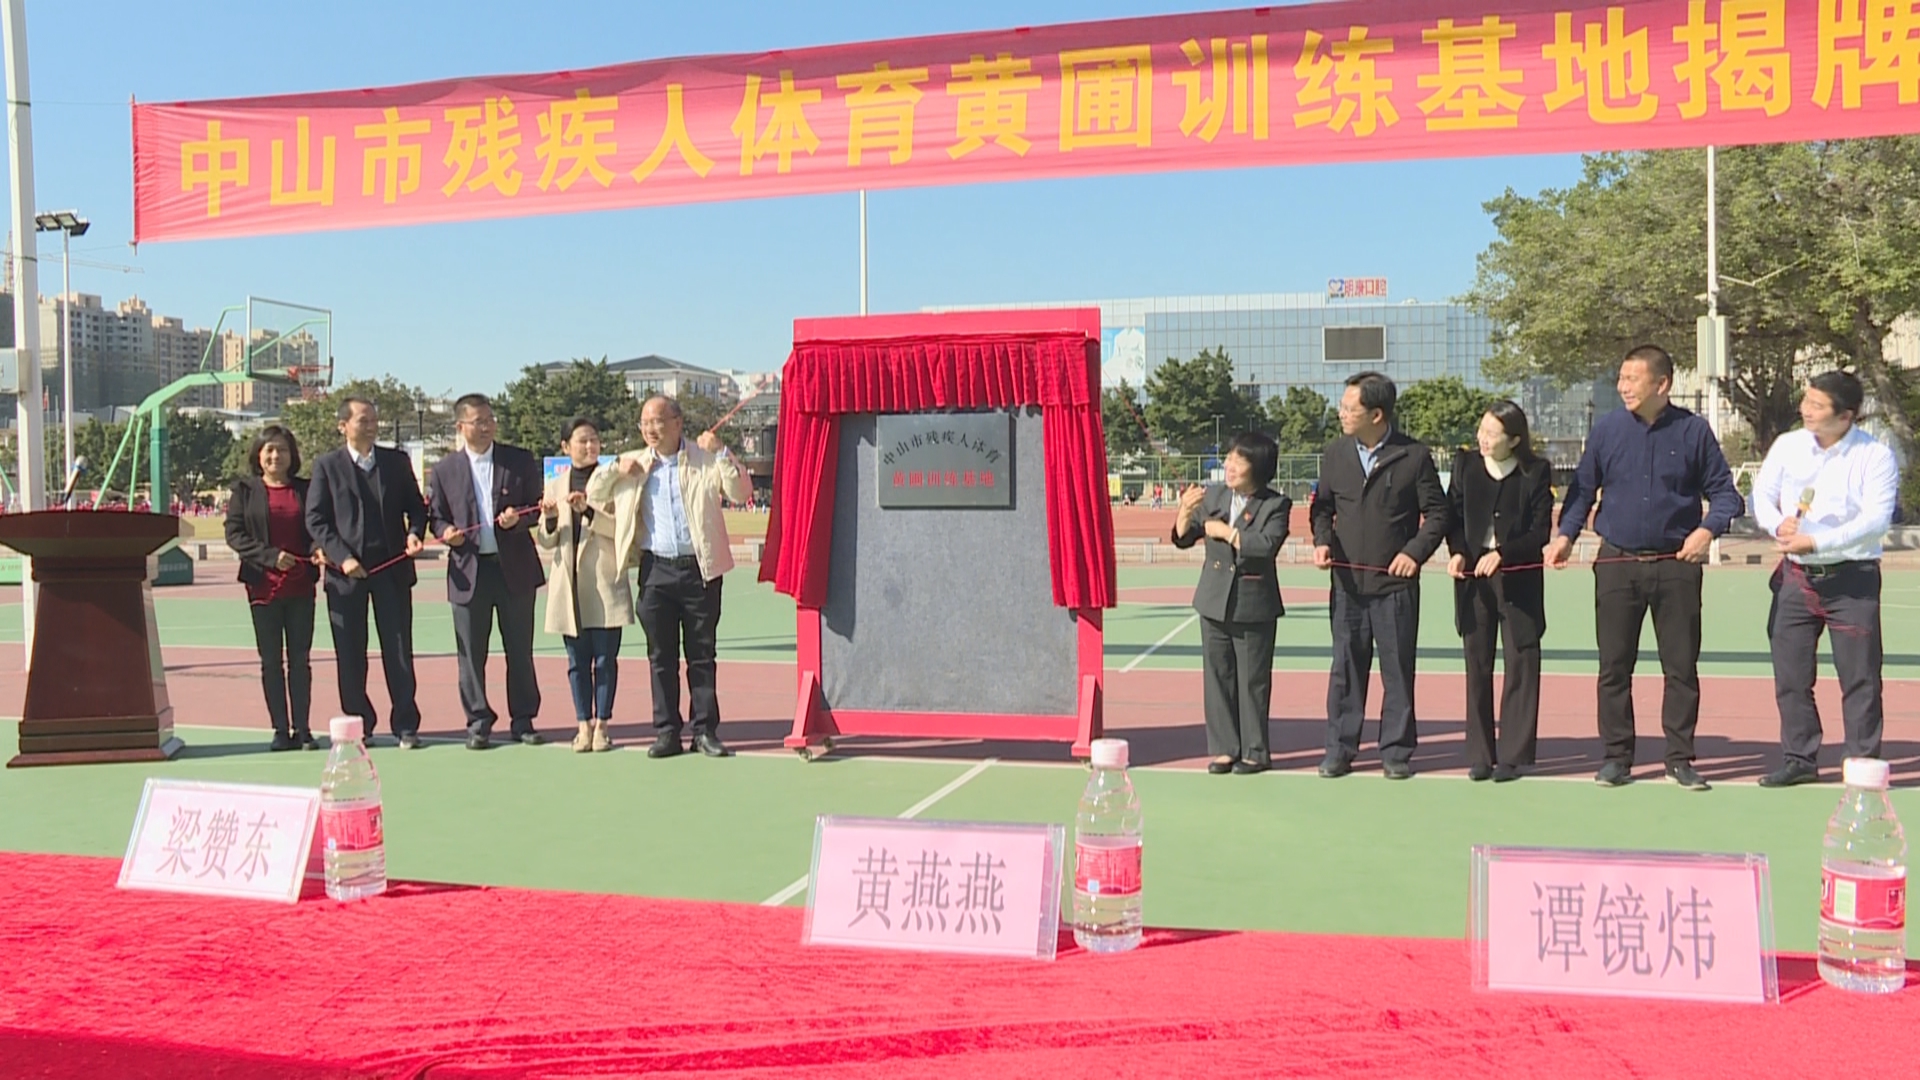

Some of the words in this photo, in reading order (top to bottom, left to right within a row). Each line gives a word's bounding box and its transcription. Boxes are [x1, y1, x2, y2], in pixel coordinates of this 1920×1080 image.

[181, 0, 1920, 218] 中山市残疾人体育黄圃训练基地揭牌
[883, 430, 1002, 466] 中山市残疾人体育
[893, 470, 995, 488] 黄圃训练基地
[156, 806, 278, 882] 梁赞东
[848, 847, 1006, 935] 黄燕燕
[1530, 882, 1716, 978] 谭镜炜
